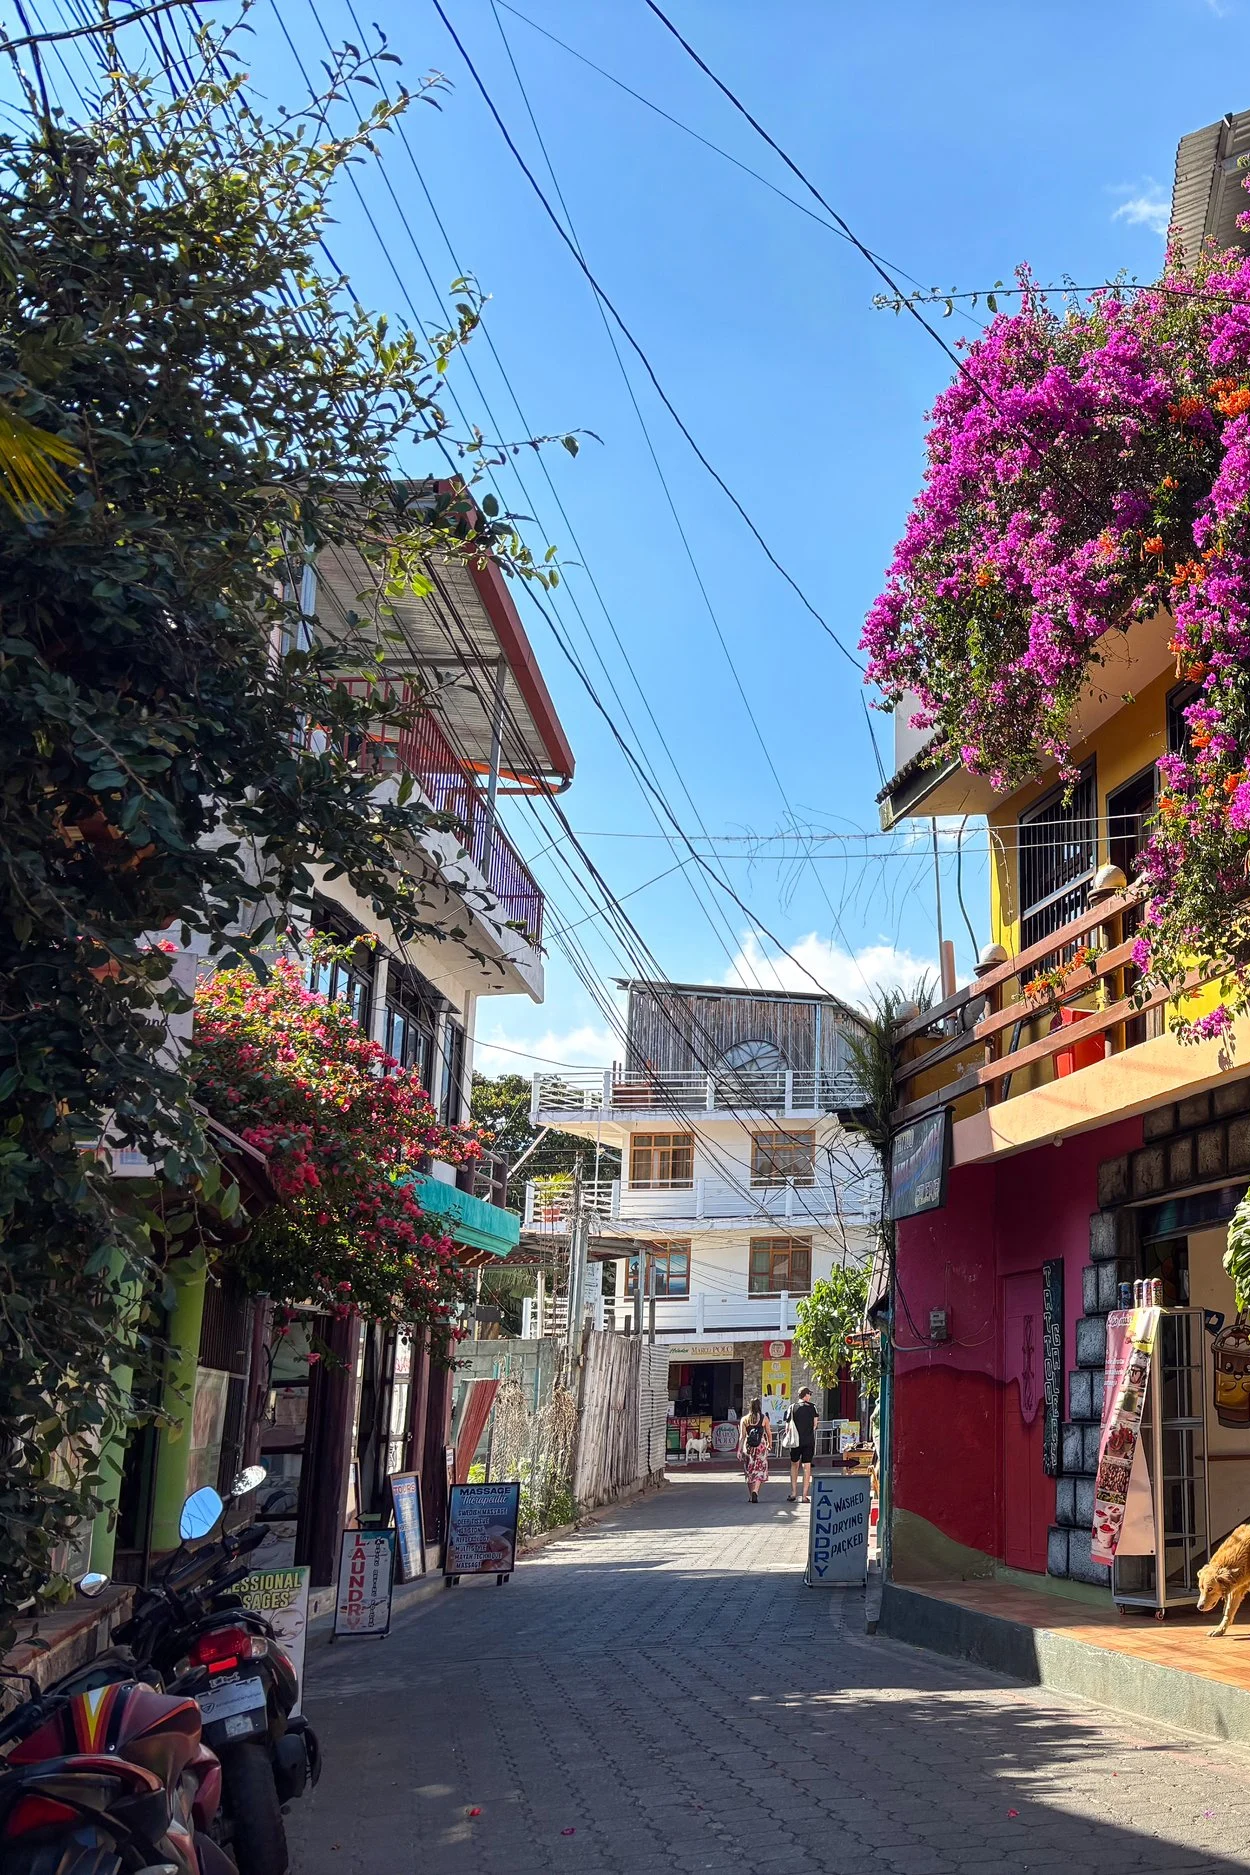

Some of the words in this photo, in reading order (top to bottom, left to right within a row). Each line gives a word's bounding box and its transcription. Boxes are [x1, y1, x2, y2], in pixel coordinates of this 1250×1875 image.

[713, 1345, 733, 1353] POLO
[716, 1436, 736, 1445] POLO
[393, 1483, 417, 1496] TOURS
[459, 1487, 512, 1496] MASSAGE
[833, 1492, 864, 1513] WASHED
[482, 1507, 508, 1516] MASSAGE
[813, 1480, 833, 1578] LAUNDRY
[832, 1512, 863, 1536] DRYING
[831, 1532, 864, 1558] PACKED
[456, 1561, 482, 1569] MASSAGE
[346, 1534, 367, 1630] LAUNDRY
